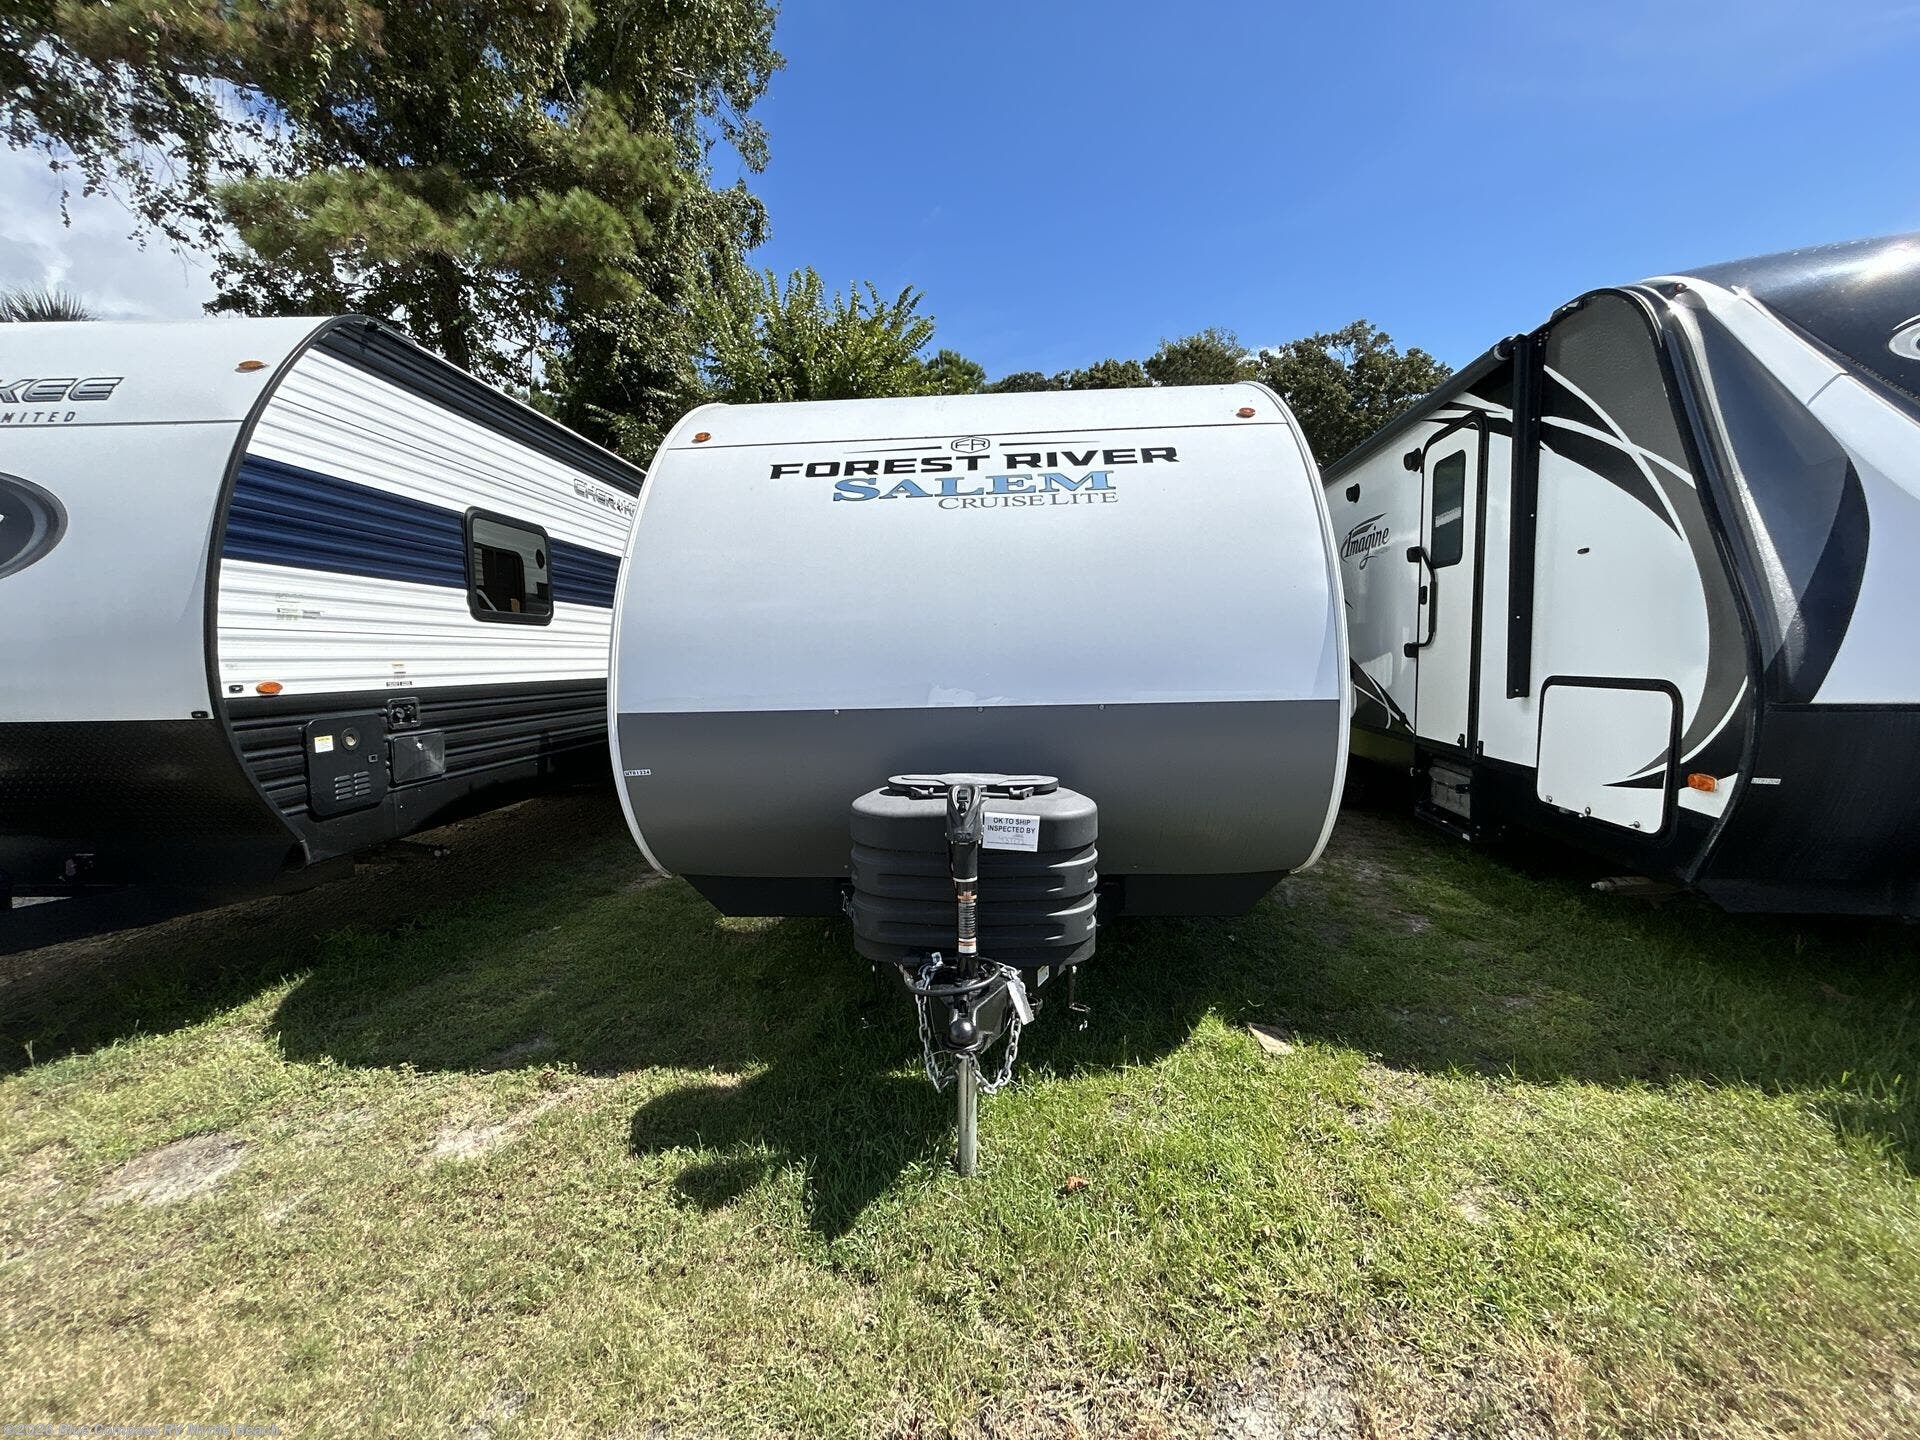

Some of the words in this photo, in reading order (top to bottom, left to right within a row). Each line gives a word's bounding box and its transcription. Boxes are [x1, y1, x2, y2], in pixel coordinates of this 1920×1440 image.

[770, 455, 990, 479] FOREST
[1003, 447, 1181, 469] RIVER
[833, 470, 1116, 502] SALEM
[1341, 526, 1389, 570] Imagine
[987, 825, 1025, 833] INSPECTED
[1005, 817, 1014, 825] TO
[1015, 818, 1031, 826] SHIP
